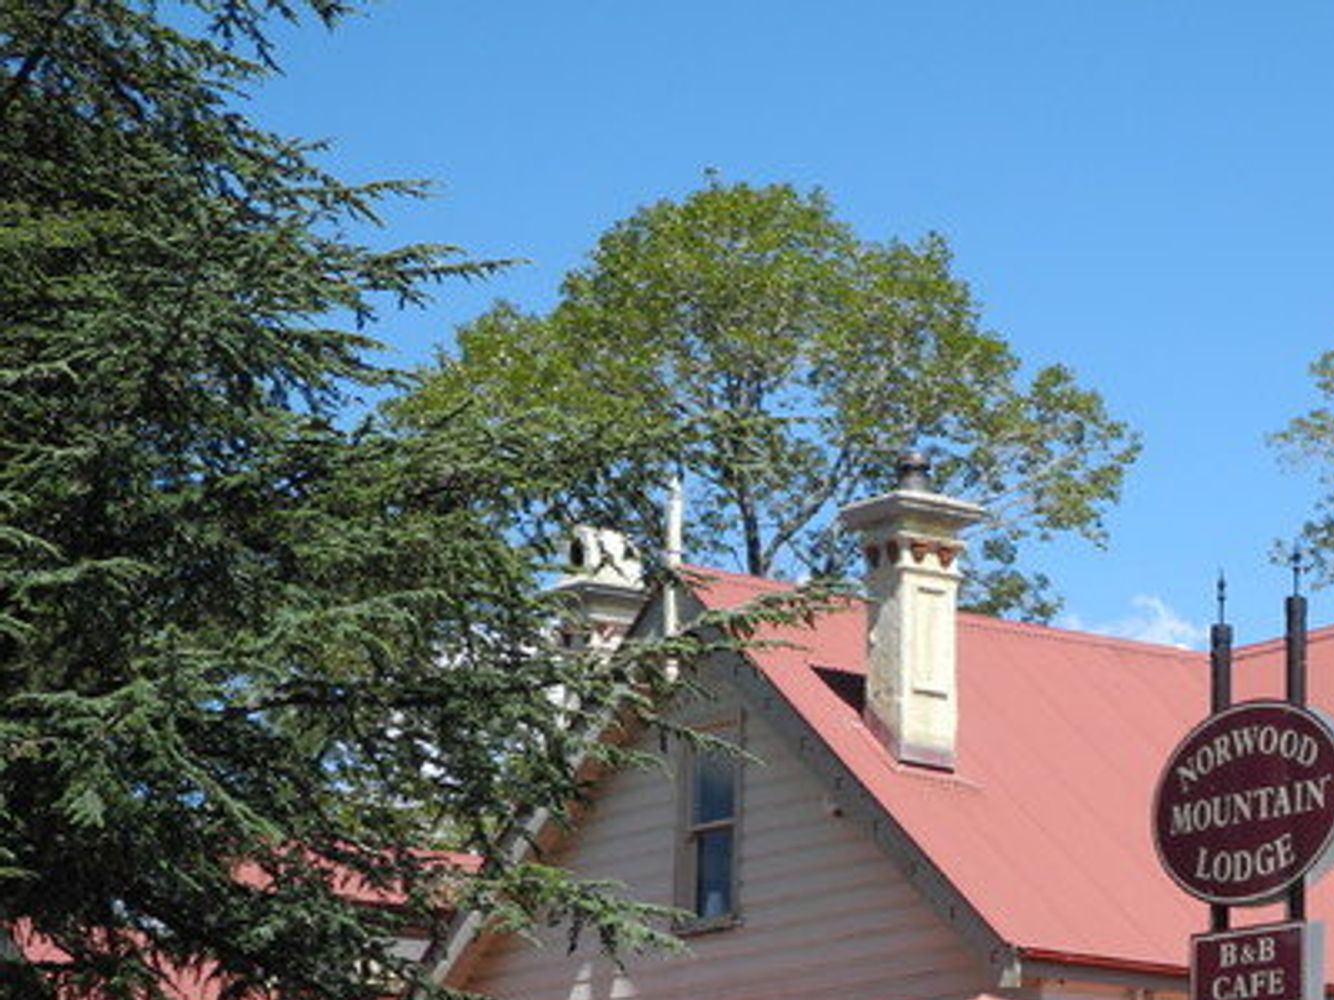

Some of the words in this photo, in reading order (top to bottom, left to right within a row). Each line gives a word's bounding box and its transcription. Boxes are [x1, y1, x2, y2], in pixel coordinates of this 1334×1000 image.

[1176, 726, 1319, 794] NORWOOD
[1170, 774, 1332, 836] MOUNTAIN
[1195, 834, 1296, 883] LODGE
[1220, 936, 1276, 968] B&B
[1212, 970, 1285, 1000] CAFE
